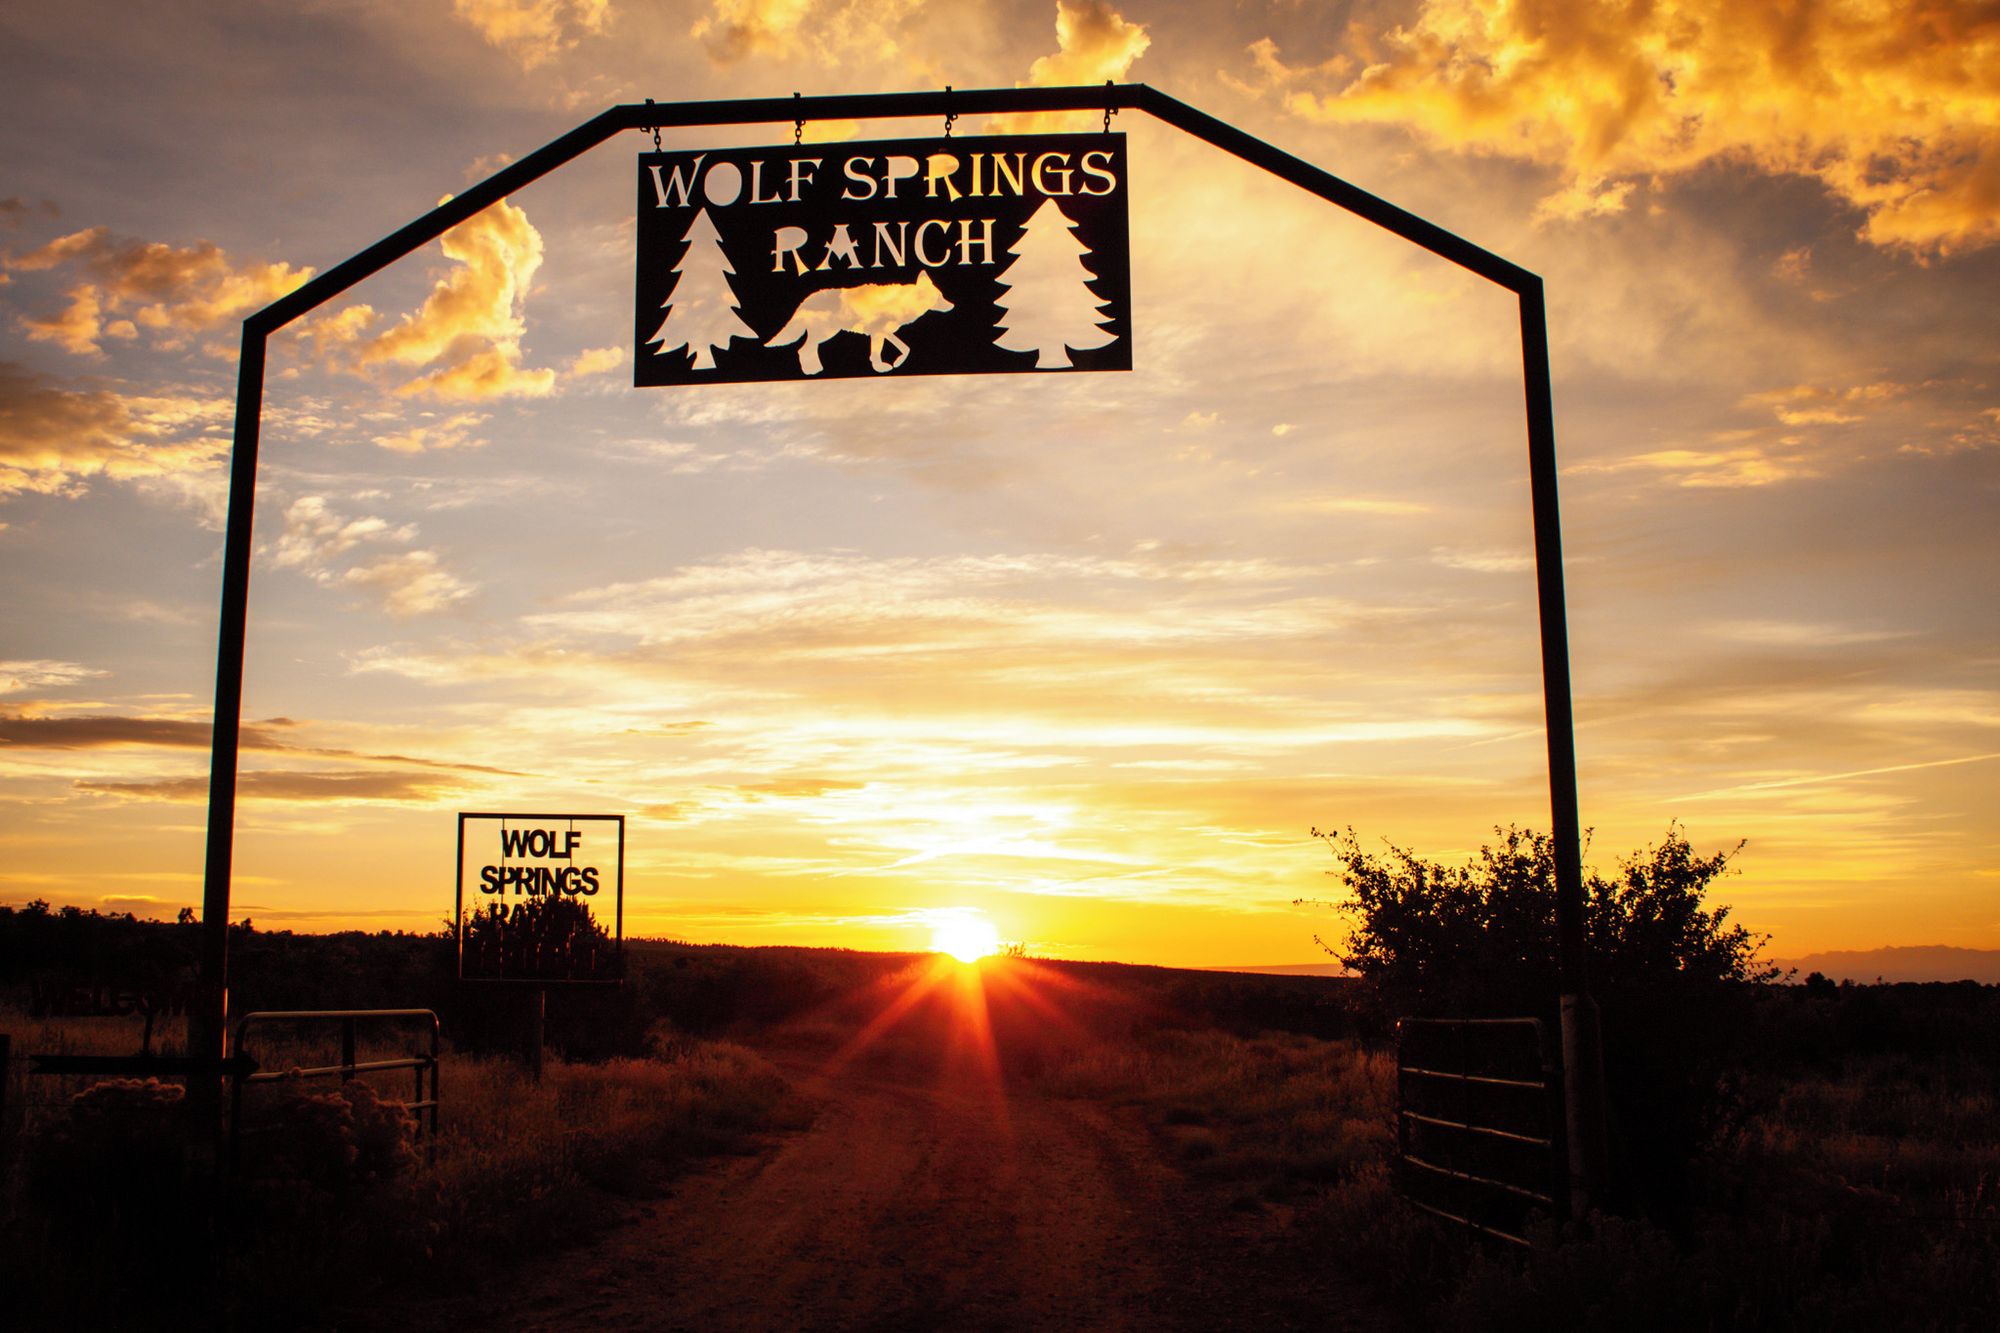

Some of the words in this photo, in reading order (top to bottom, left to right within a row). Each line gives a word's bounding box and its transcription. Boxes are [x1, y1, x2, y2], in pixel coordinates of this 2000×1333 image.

[649, 153, 823, 208] WOLF
[841, 151, 1117, 202] SPRINGS
[771, 219, 996, 276] RANCH
[501, 829, 581, 858] WOLF
[480, 866, 599, 895] SPRINGS
